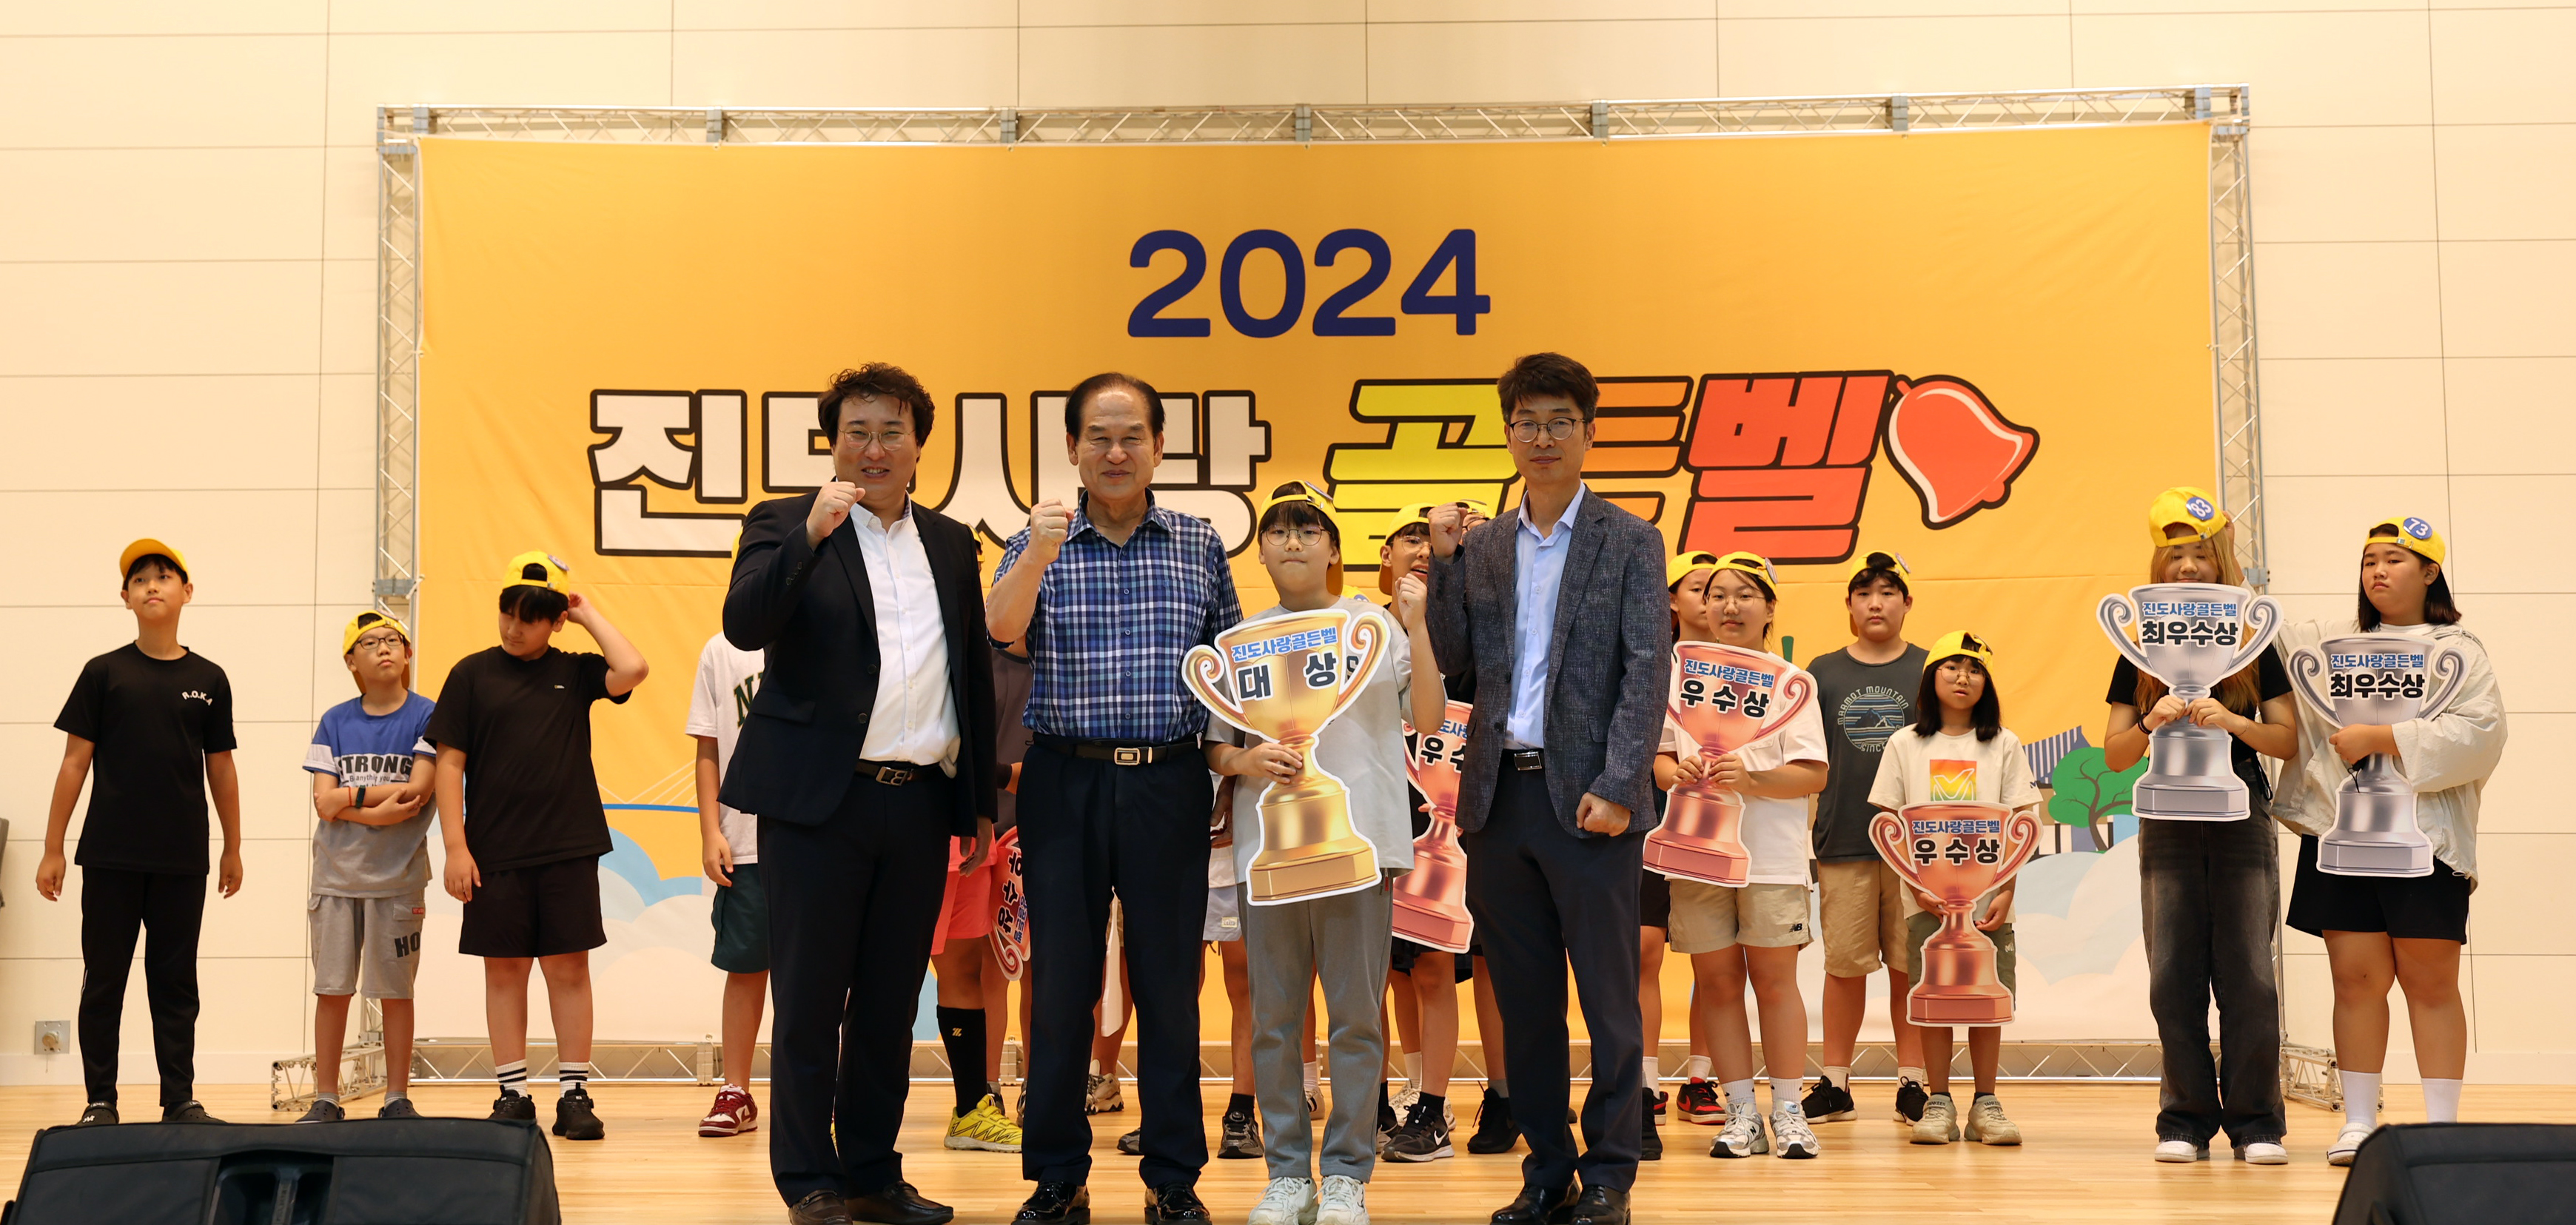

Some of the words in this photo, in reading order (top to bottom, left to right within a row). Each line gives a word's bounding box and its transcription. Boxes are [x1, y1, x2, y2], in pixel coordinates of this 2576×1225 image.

[1127, 229, 1491, 338] 2024
[2191, 499, 2212, 517] 83
[2408, 518, 2429, 537] 73
[2143, 603, 2237, 617] 진도사랑골든벨
[1232, 627, 1338, 662] 진도사랑골든벨
[2141, 620, 2238, 646] 최우수상
[2331, 654, 2424, 668] 진도사랑골든벨
[1685, 660, 1774, 688] 진도사랑골든벨
[2330, 674, 2426, 699] 최우수상
[1865, 685, 1909, 710] MOUNTAIN
[1912, 820, 2000, 834] 진도사랑골든벨
